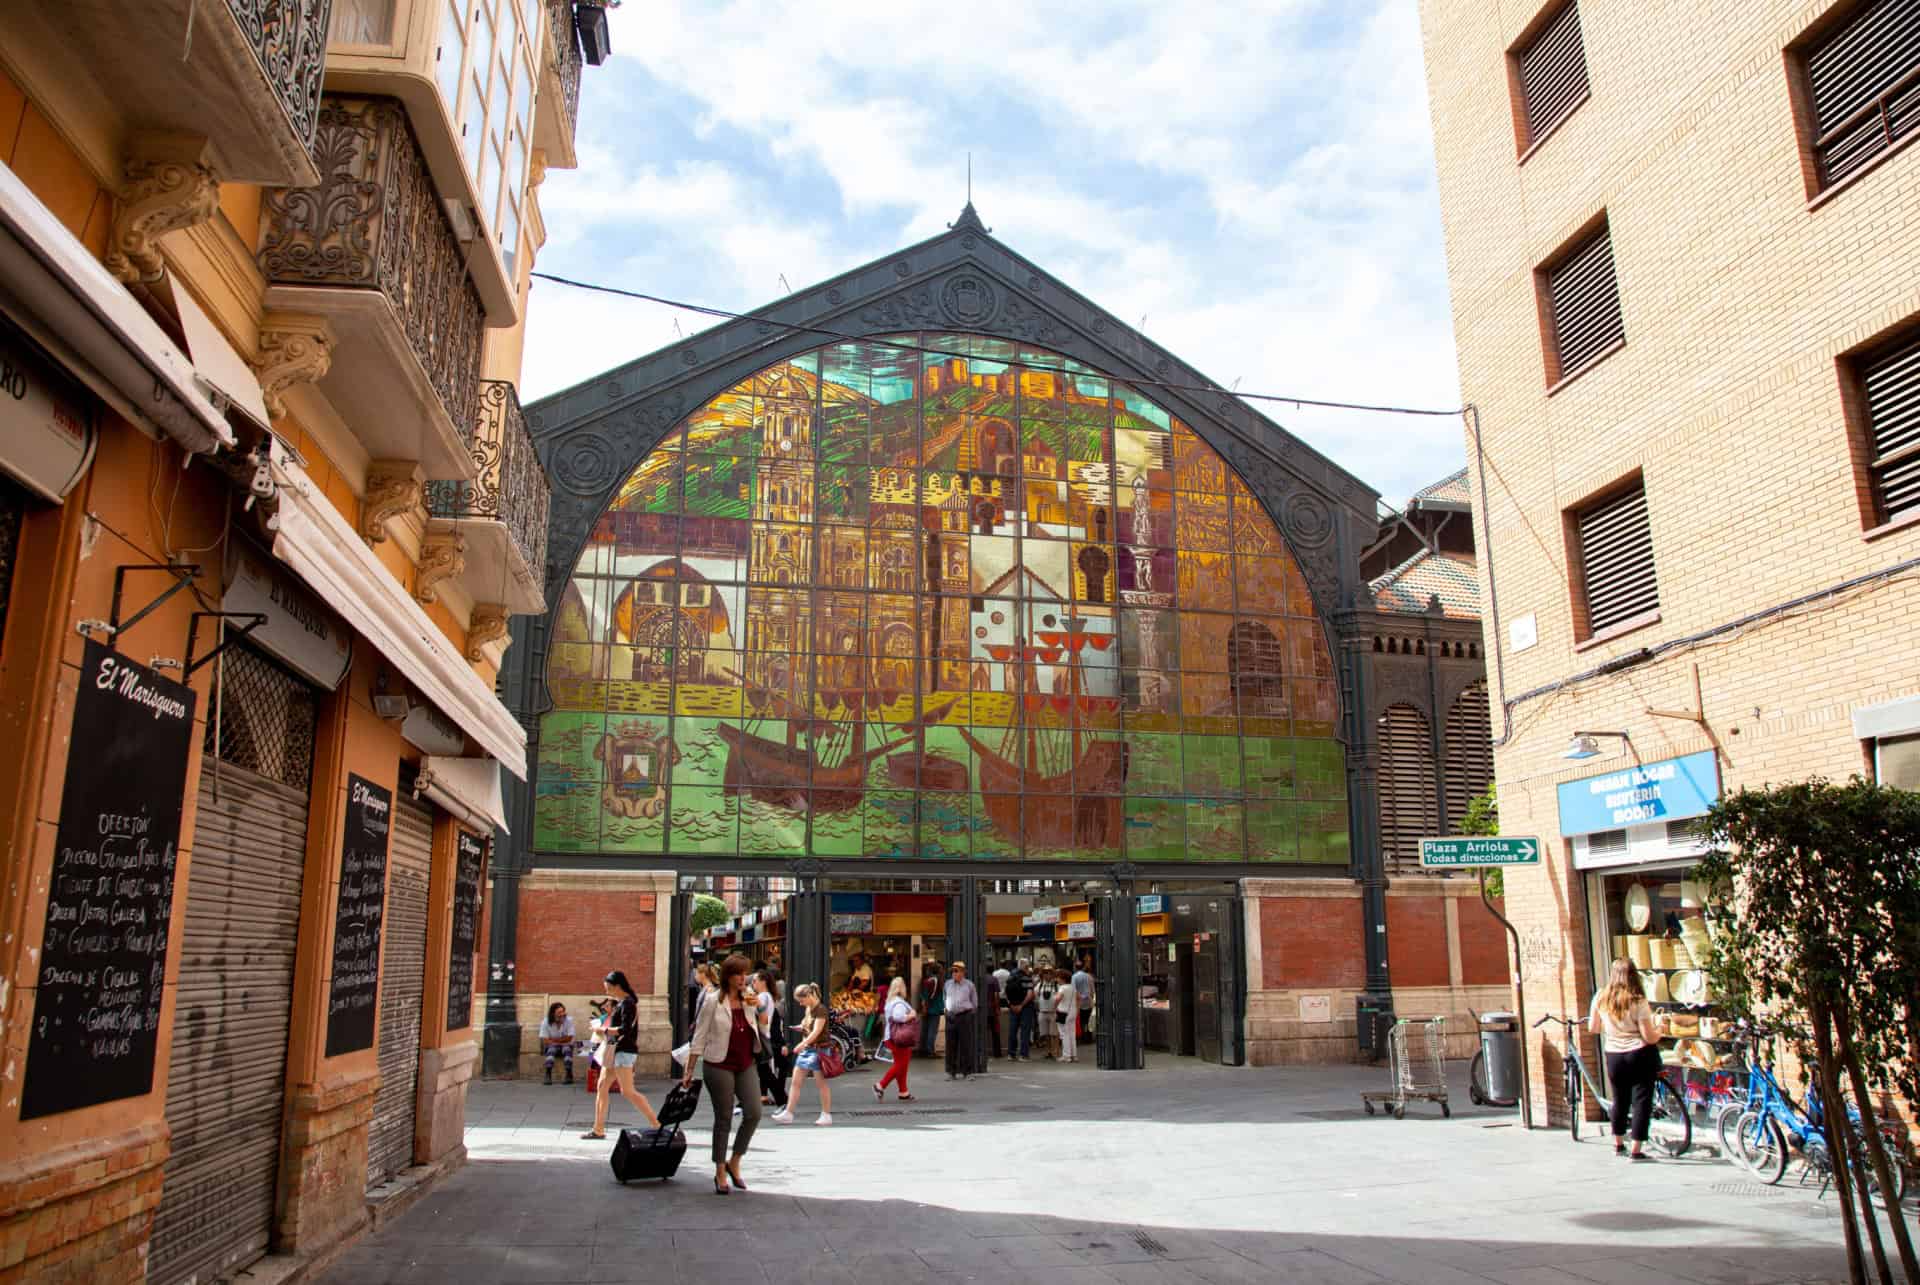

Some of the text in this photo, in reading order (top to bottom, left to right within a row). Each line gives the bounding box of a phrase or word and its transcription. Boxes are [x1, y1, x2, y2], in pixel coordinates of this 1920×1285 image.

[96, 657, 185, 720] El Marisquero
[1424, 841, 1509, 853] Plaza Arriola
[1425, 852, 1519, 863] Todas direcciones
